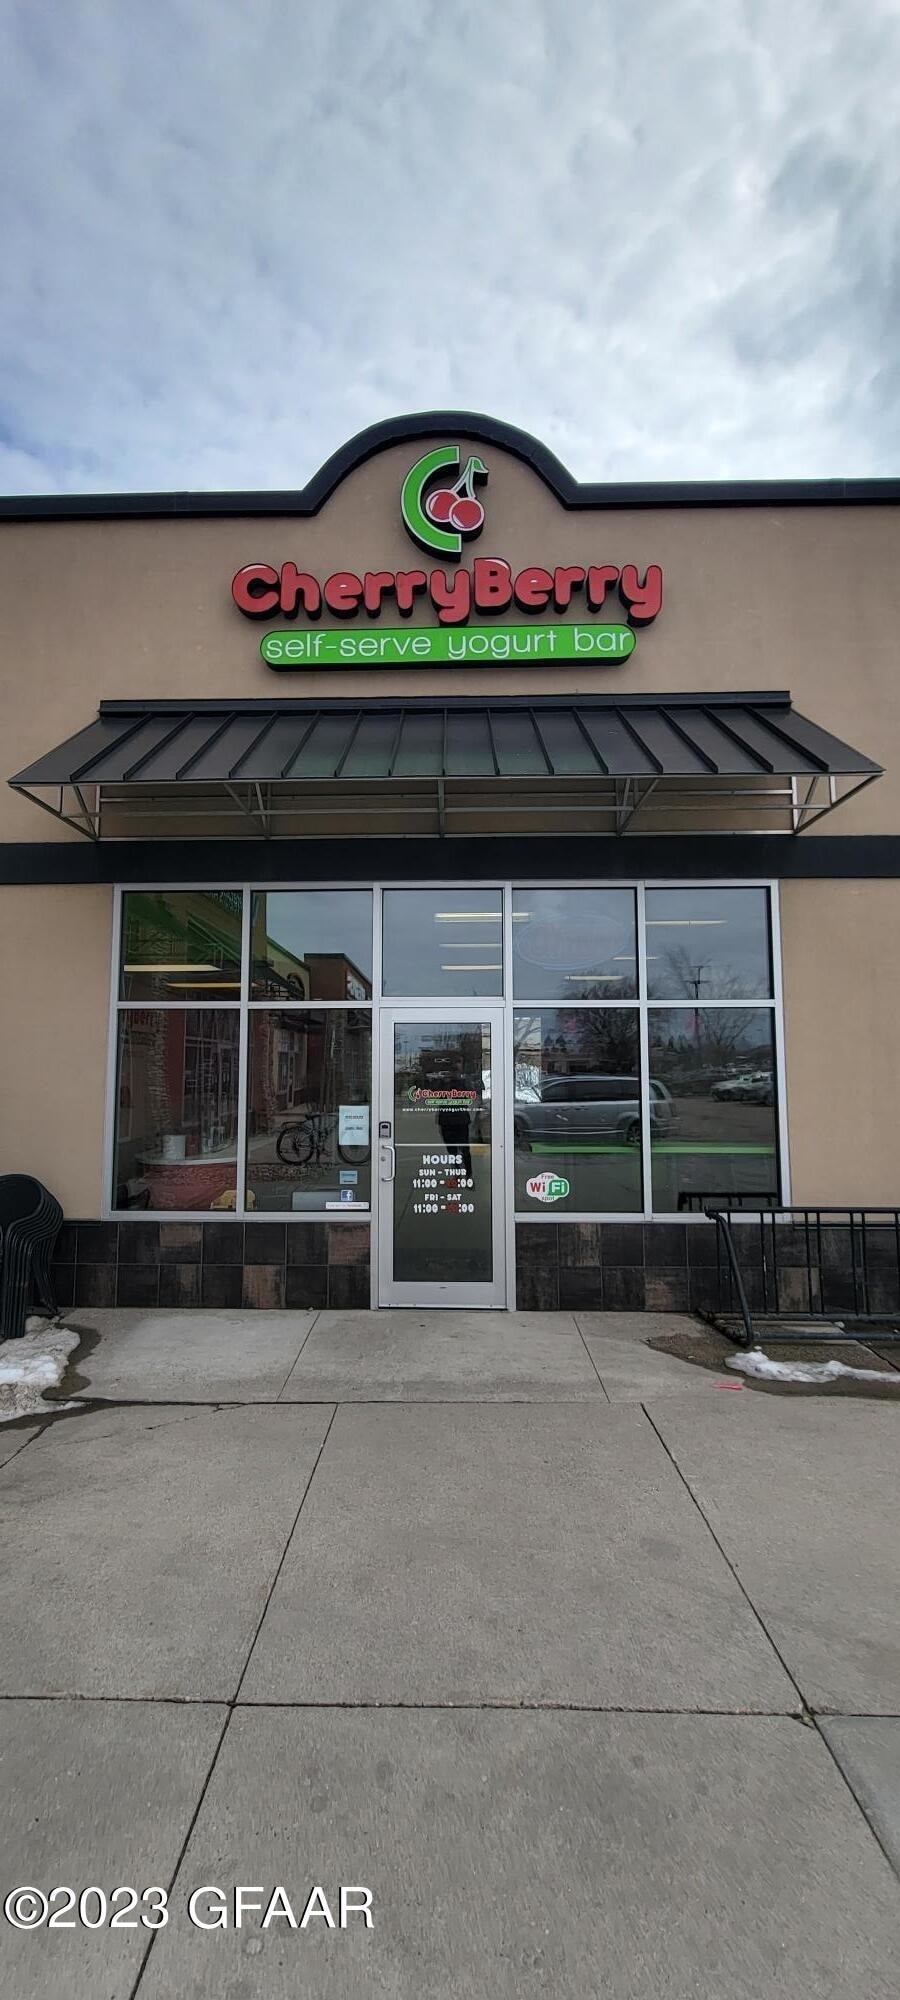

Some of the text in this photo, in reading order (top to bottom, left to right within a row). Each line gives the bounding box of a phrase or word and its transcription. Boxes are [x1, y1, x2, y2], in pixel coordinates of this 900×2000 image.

[231, 557, 663, 626] CherryBerry
[266, 627, 631, 659] self-serve yogurt bar
[421, 1089, 477, 1099] CherryBerry
[422, 1154, 463, 1165] HOURS
[418, 1168, 436, 1176] SUN
[444, 1168, 467, 1176] THUR
[412, 1178, 438, 1188] 11:00
[424, 1193, 439, 1201] FRI
[446, 1193, 462, 1201] SAT
[413, 1203, 439, 1213] 11:00
